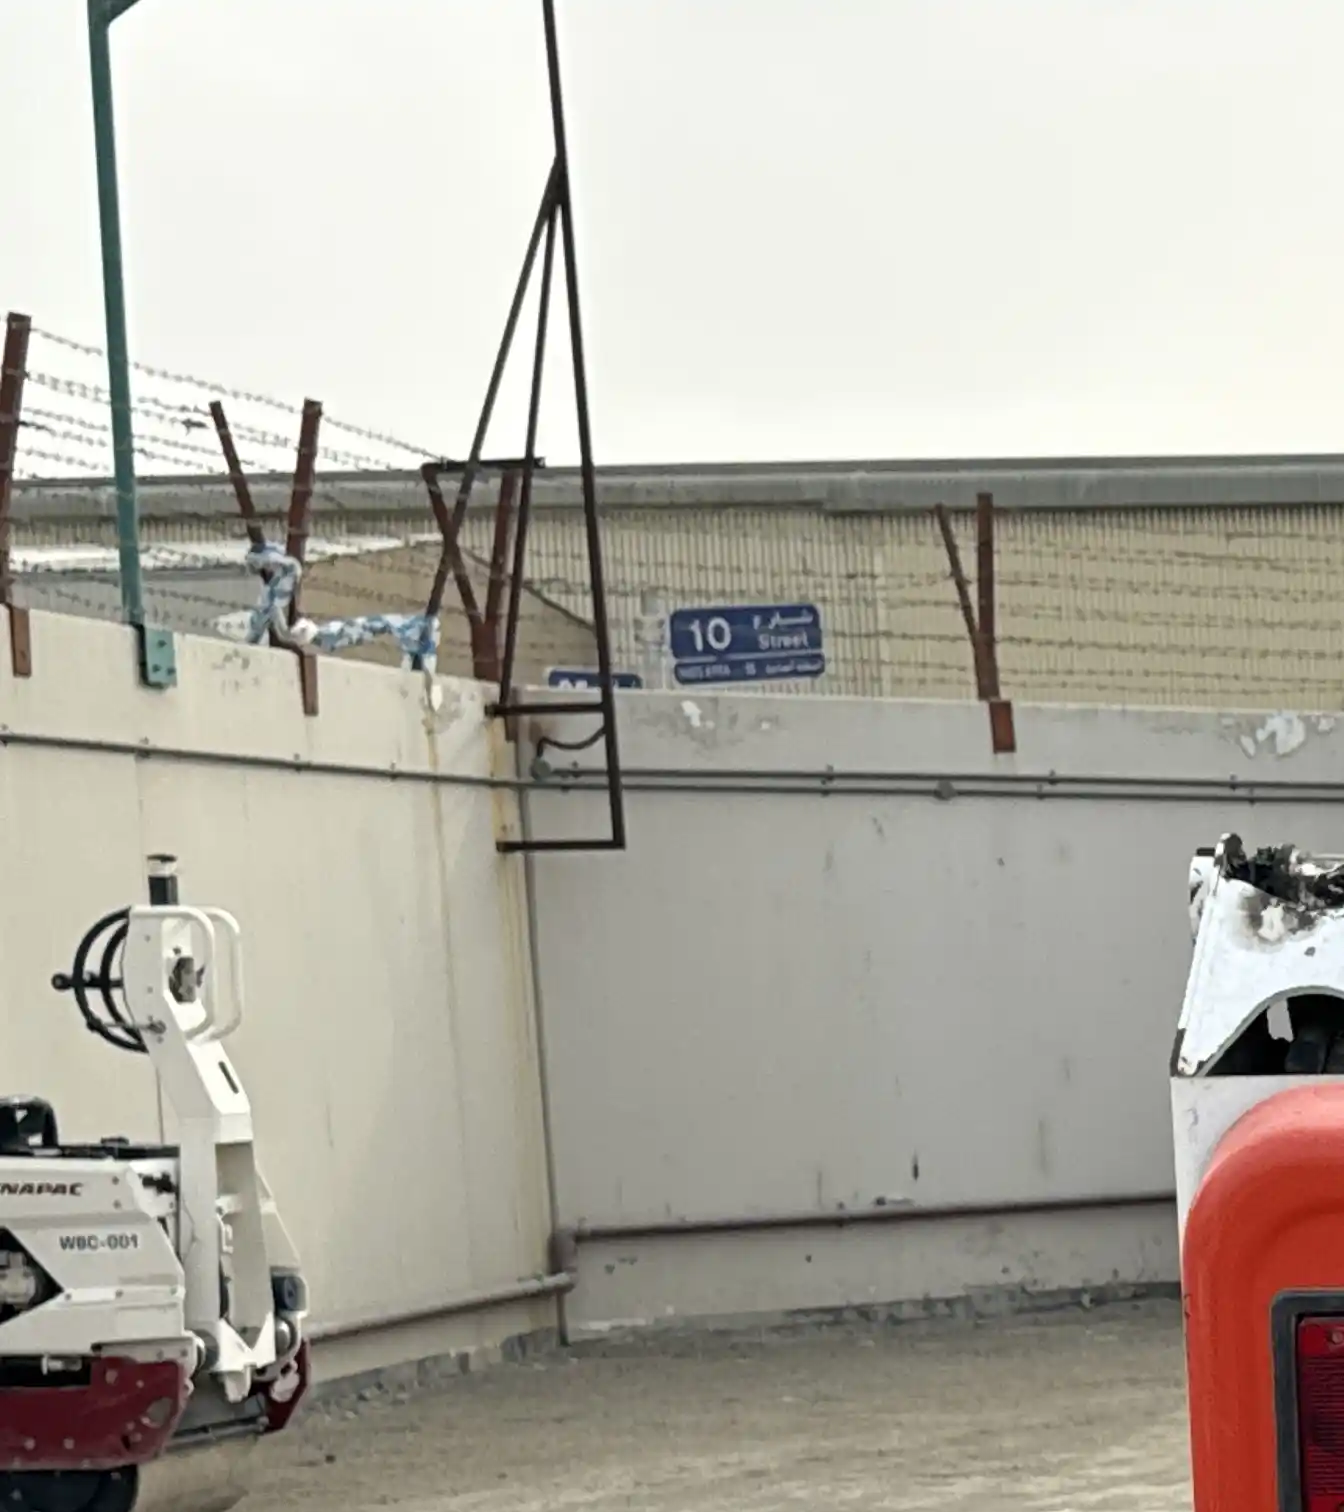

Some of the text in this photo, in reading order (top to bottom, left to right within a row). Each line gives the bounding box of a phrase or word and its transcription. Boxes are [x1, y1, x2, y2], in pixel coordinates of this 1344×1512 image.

[689, 616, 731, 652] 10
[758, 630, 810, 650] Street
[0, 1182, 84, 1197] NAPAC
